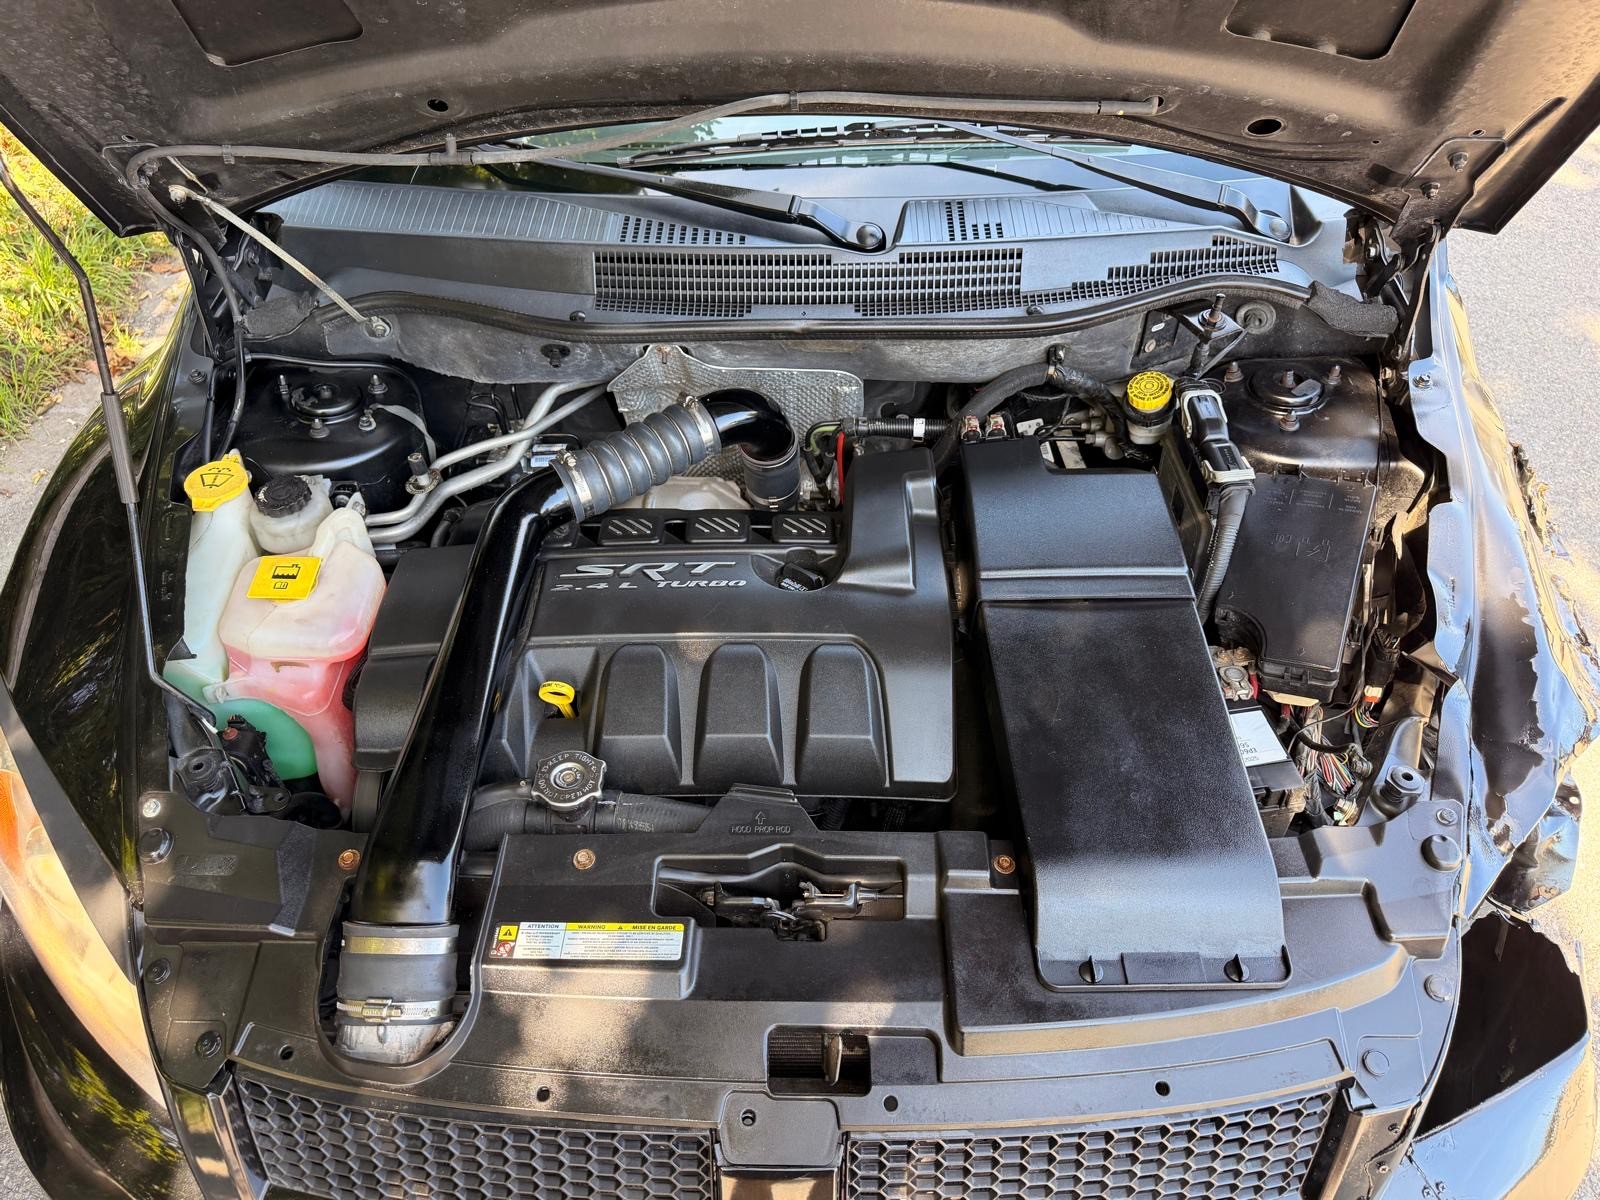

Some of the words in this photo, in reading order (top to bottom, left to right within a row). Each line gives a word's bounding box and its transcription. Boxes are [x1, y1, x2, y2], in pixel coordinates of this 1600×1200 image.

[560, 562, 736, 581] SRT
[550, 582, 609, 591] 2.4
[657, 580, 747, 588] TURBO
[548, 753, 569, 766] KEEP
[575, 753, 595, 766] TIGHT
[538, 779, 547, 789] DO
[560, 791, 583, 800] OPEN
[583, 780, 596, 793] HOT
[731, 825, 752, 833] HOOD
[754, 825, 774, 833] PROP
[775, 825, 791, 834] ROD
